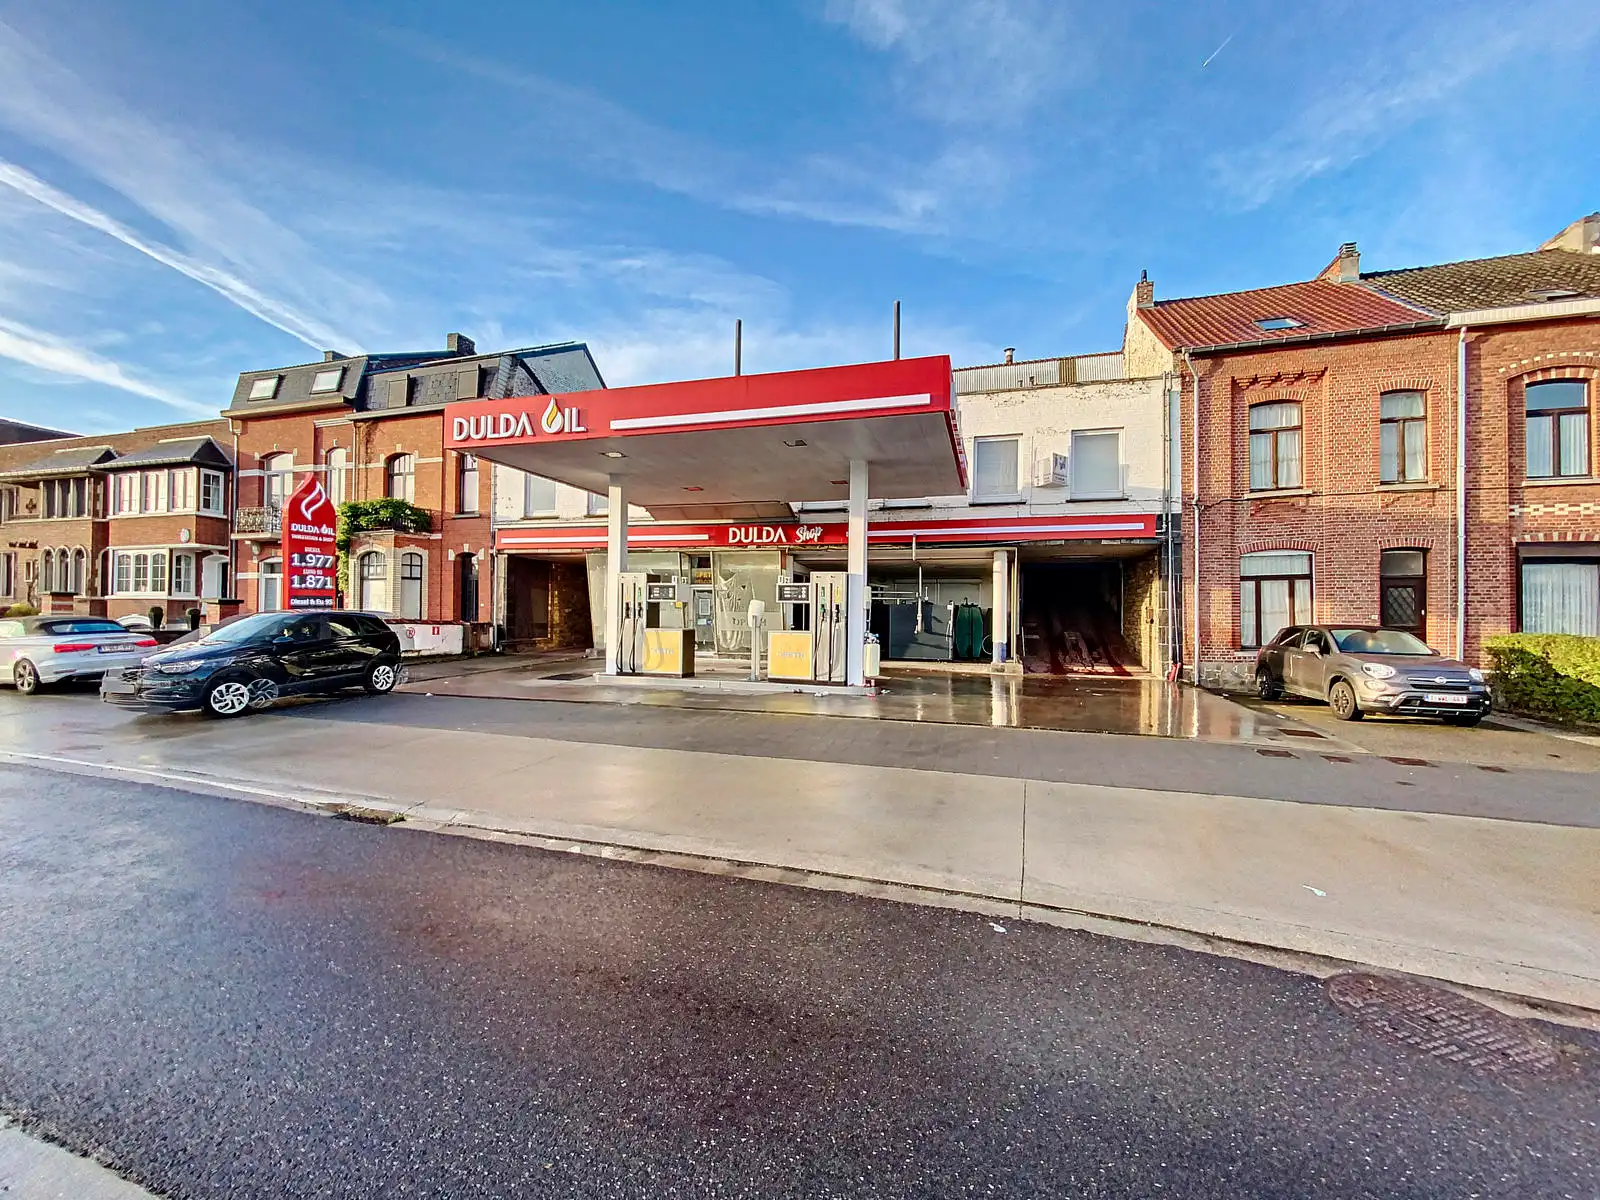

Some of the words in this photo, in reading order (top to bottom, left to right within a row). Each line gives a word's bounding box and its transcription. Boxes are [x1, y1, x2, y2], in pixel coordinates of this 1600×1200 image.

[453, 411, 534, 441] DULDA
[541, 397, 587, 433] OIL
[290, 523, 320, 534] DULDA
[320, 524, 334, 536] OIL
[728, 526, 786, 543] DULDA
[795, 525, 823, 543] Shop
[292, 554, 333, 568] 1.977
[292, 575, 333, 588] 1.871
